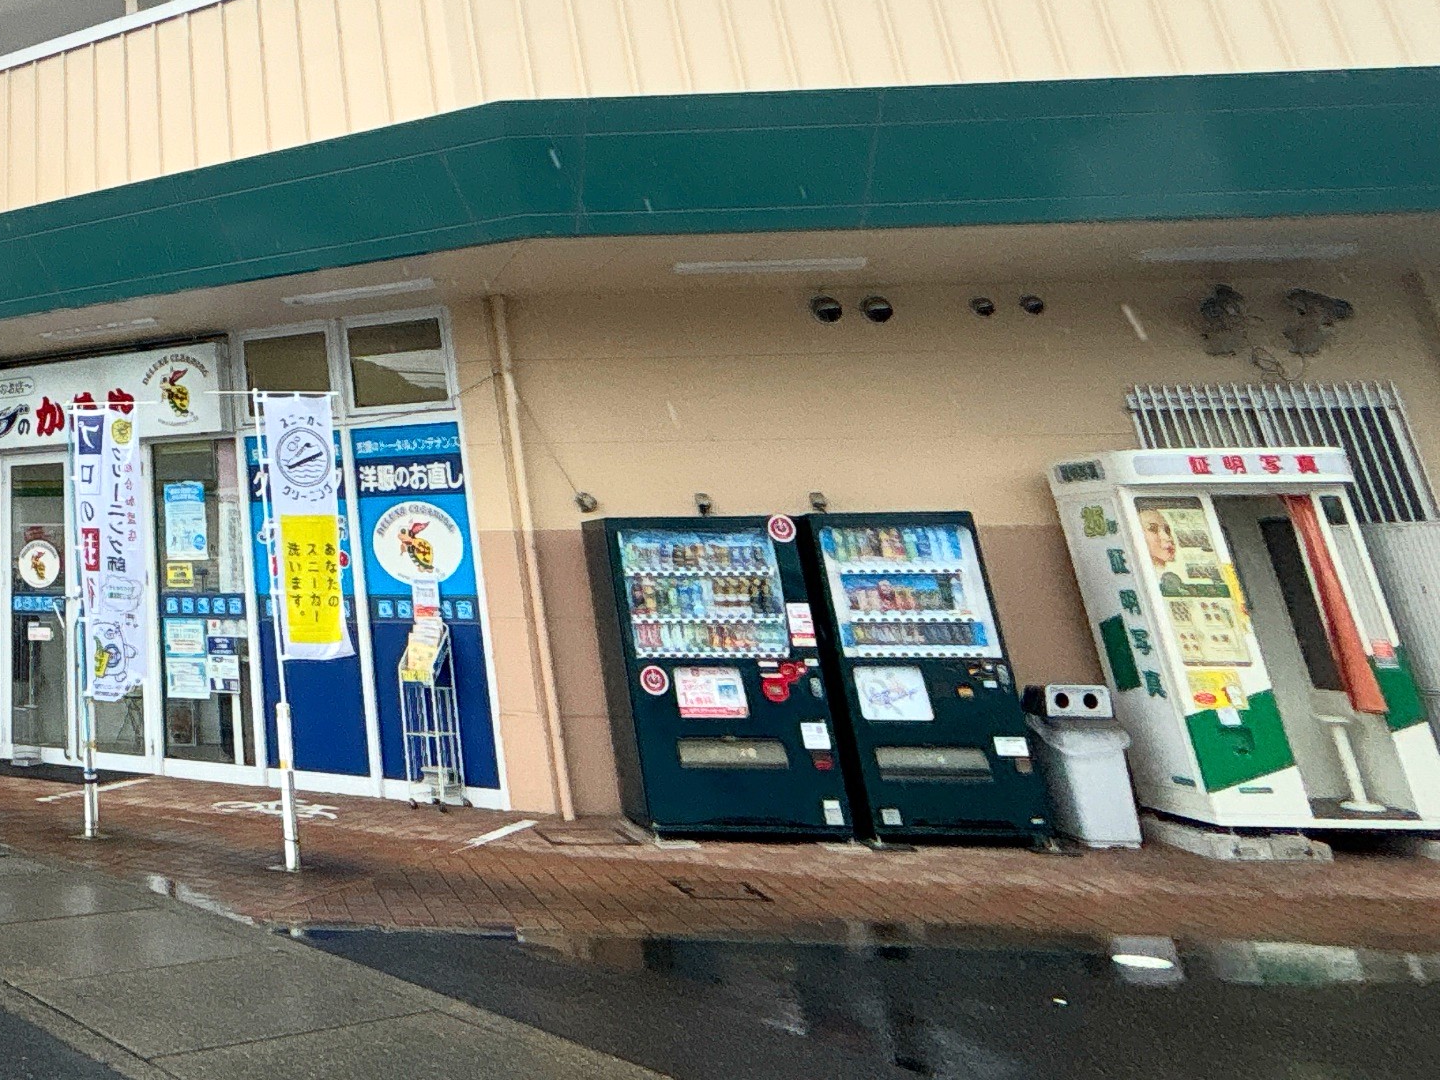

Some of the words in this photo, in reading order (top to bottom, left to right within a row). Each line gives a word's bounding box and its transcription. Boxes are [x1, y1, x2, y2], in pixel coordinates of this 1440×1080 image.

[280, 414, 324, 428] スニーカー
[359, 461, 463, 493] 洋服のお直し
[1188, 454, 1319, 475] 証明写真
[282, 483, 334, 502] クリーニング
[307, 543, 322, 623] スニーカー
[324, 542, 340, 608] あなたの
